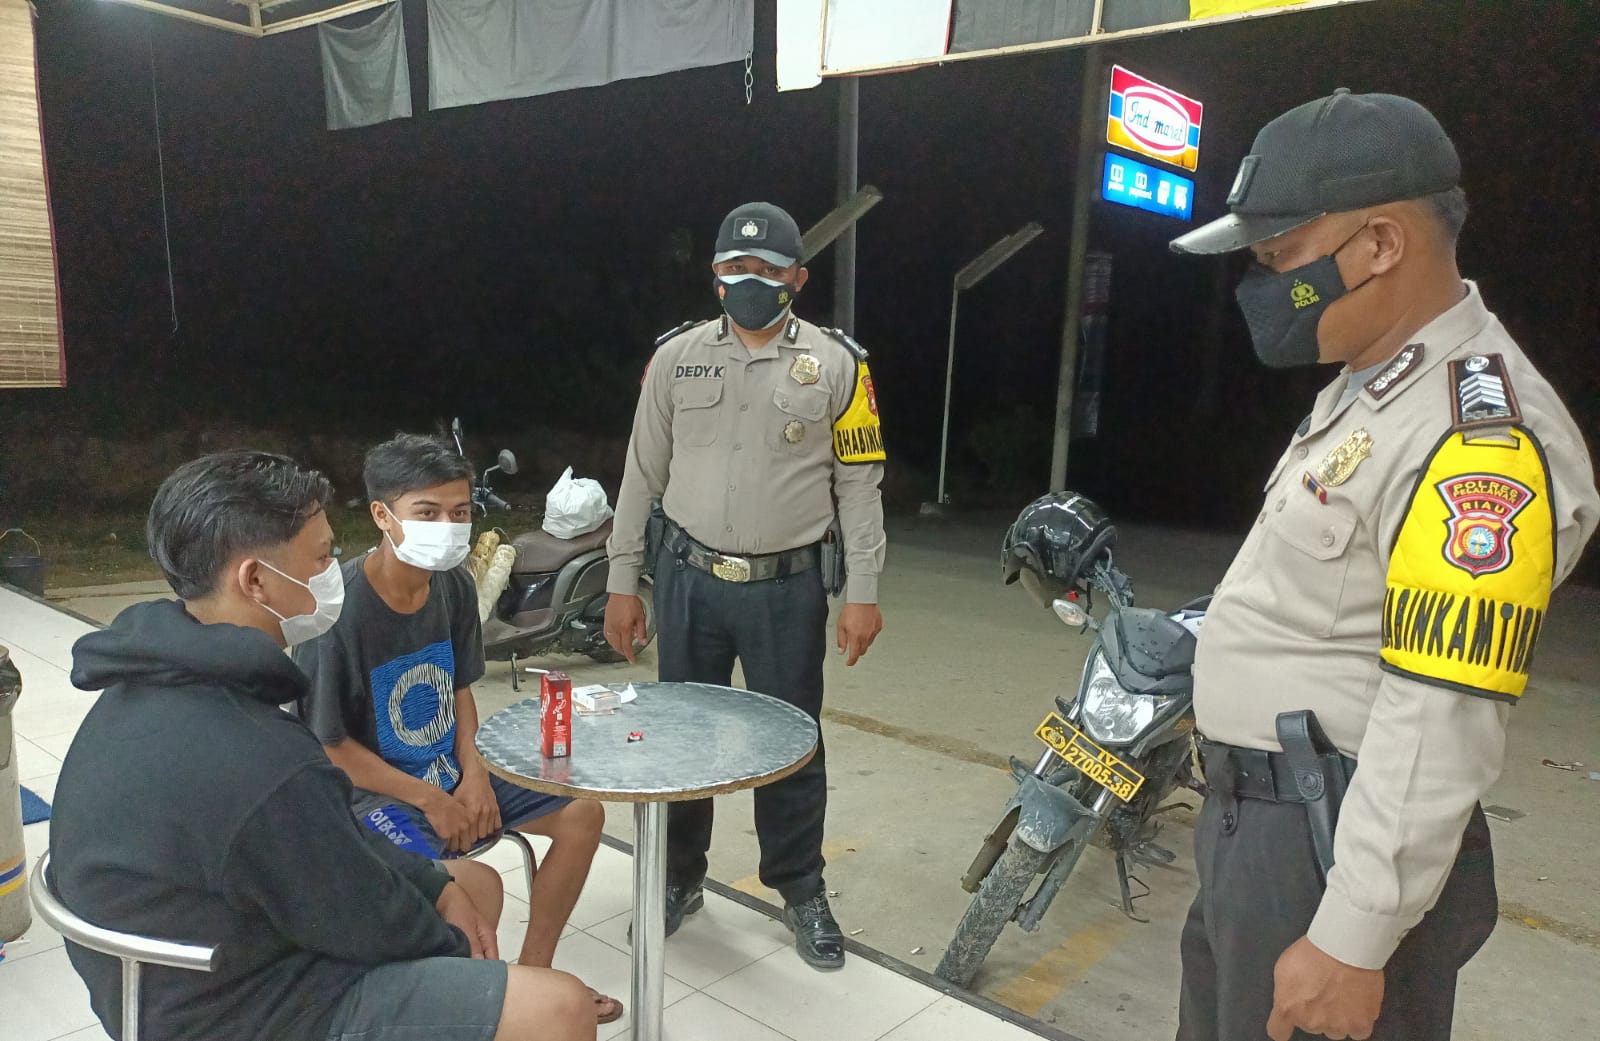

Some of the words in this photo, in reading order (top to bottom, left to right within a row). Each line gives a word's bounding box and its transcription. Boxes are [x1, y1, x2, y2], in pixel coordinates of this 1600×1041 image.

[1295, 295, 1320, 309] POLRI
[675, 365, 725, 378] DEDY.K
[1452, 480, 1519, 499] POLRES
[1462, 501, 1506, 514] RIAU
[1097, 750, 1120, 767] IV
[1065, 746, 1132, 798] 27005-38
